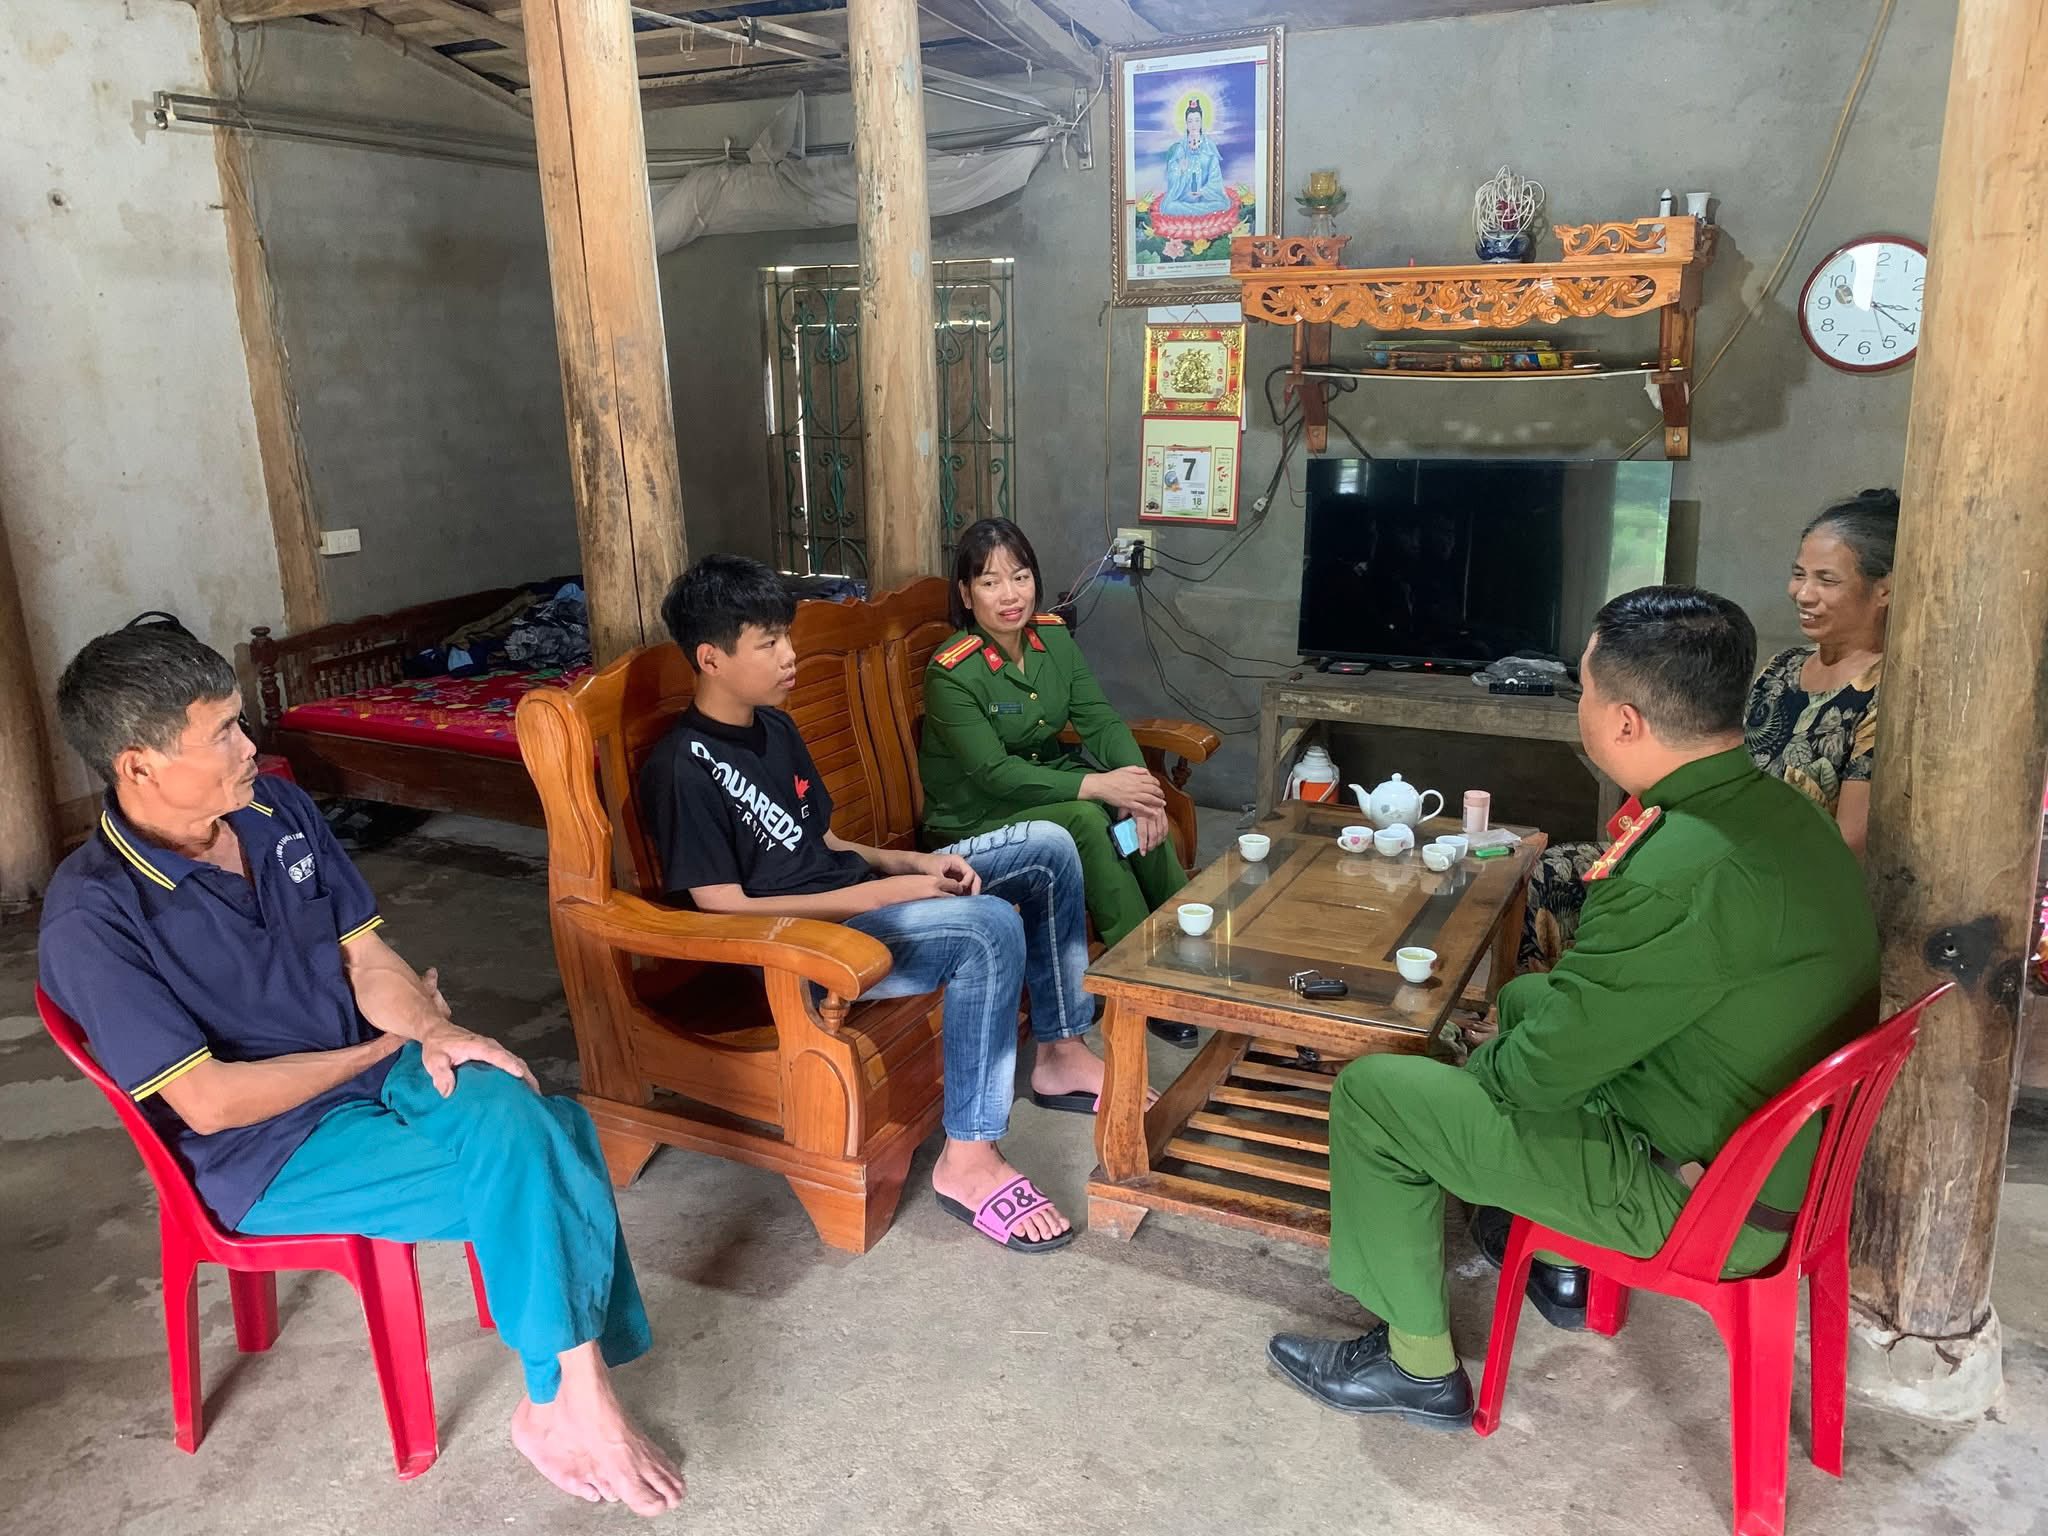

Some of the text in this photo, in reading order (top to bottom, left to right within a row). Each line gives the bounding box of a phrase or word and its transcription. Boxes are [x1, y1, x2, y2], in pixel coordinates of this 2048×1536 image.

[1904, 259, 1909, 272] 1
[1830, 275, 1847, 288] 10
[1817, 296, 1831, 310] 9
[1820, 318, 1834, 332] 8
[1903, 322, 1916, 335] 4
[1836, 333, 1848, 346] 7
[1883, 335, 1896, 349] 5
[1857, 341, 1871, 355] 6
[1183, 458, 1196, 480] 7
[1192, 497, 1202, 506] 18
